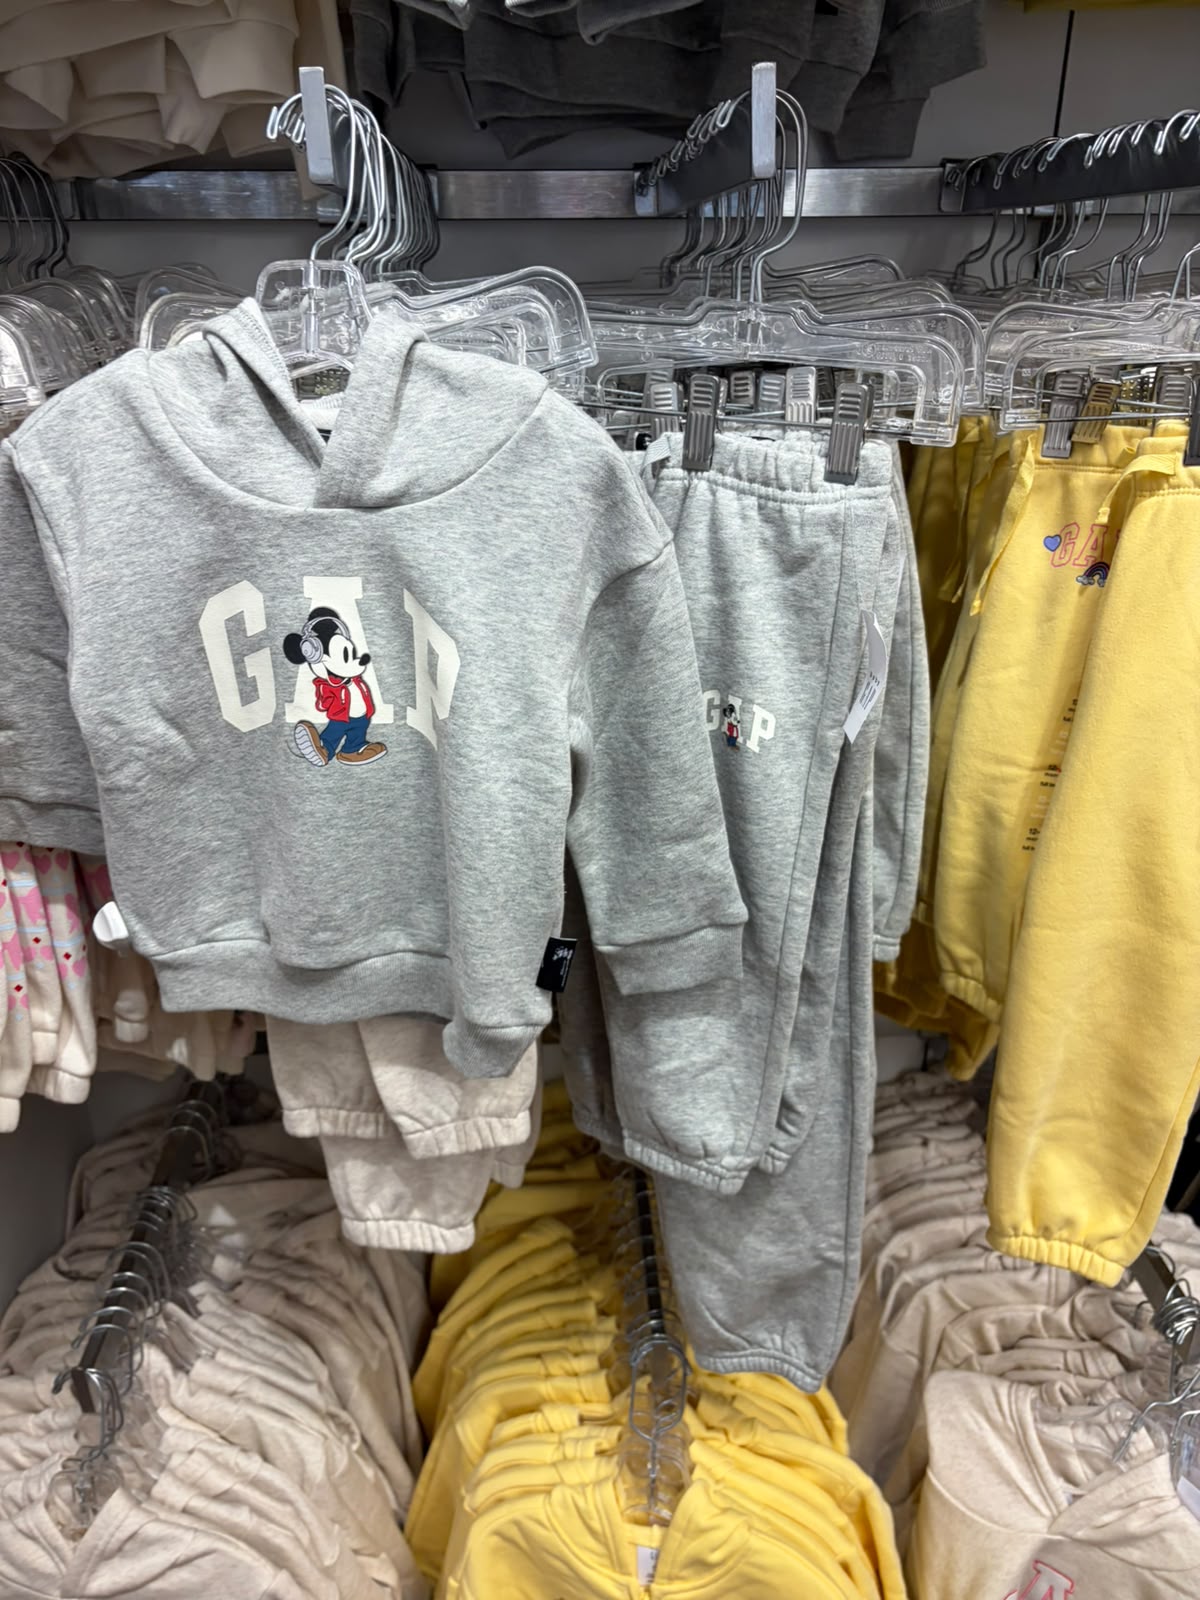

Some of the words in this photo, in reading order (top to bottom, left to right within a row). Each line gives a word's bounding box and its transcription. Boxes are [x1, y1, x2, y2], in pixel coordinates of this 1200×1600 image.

[1051, 522, 1121, 568] GA
[198, 576, 461, 750] GAP
[703, 689, 777, 754] GAP
